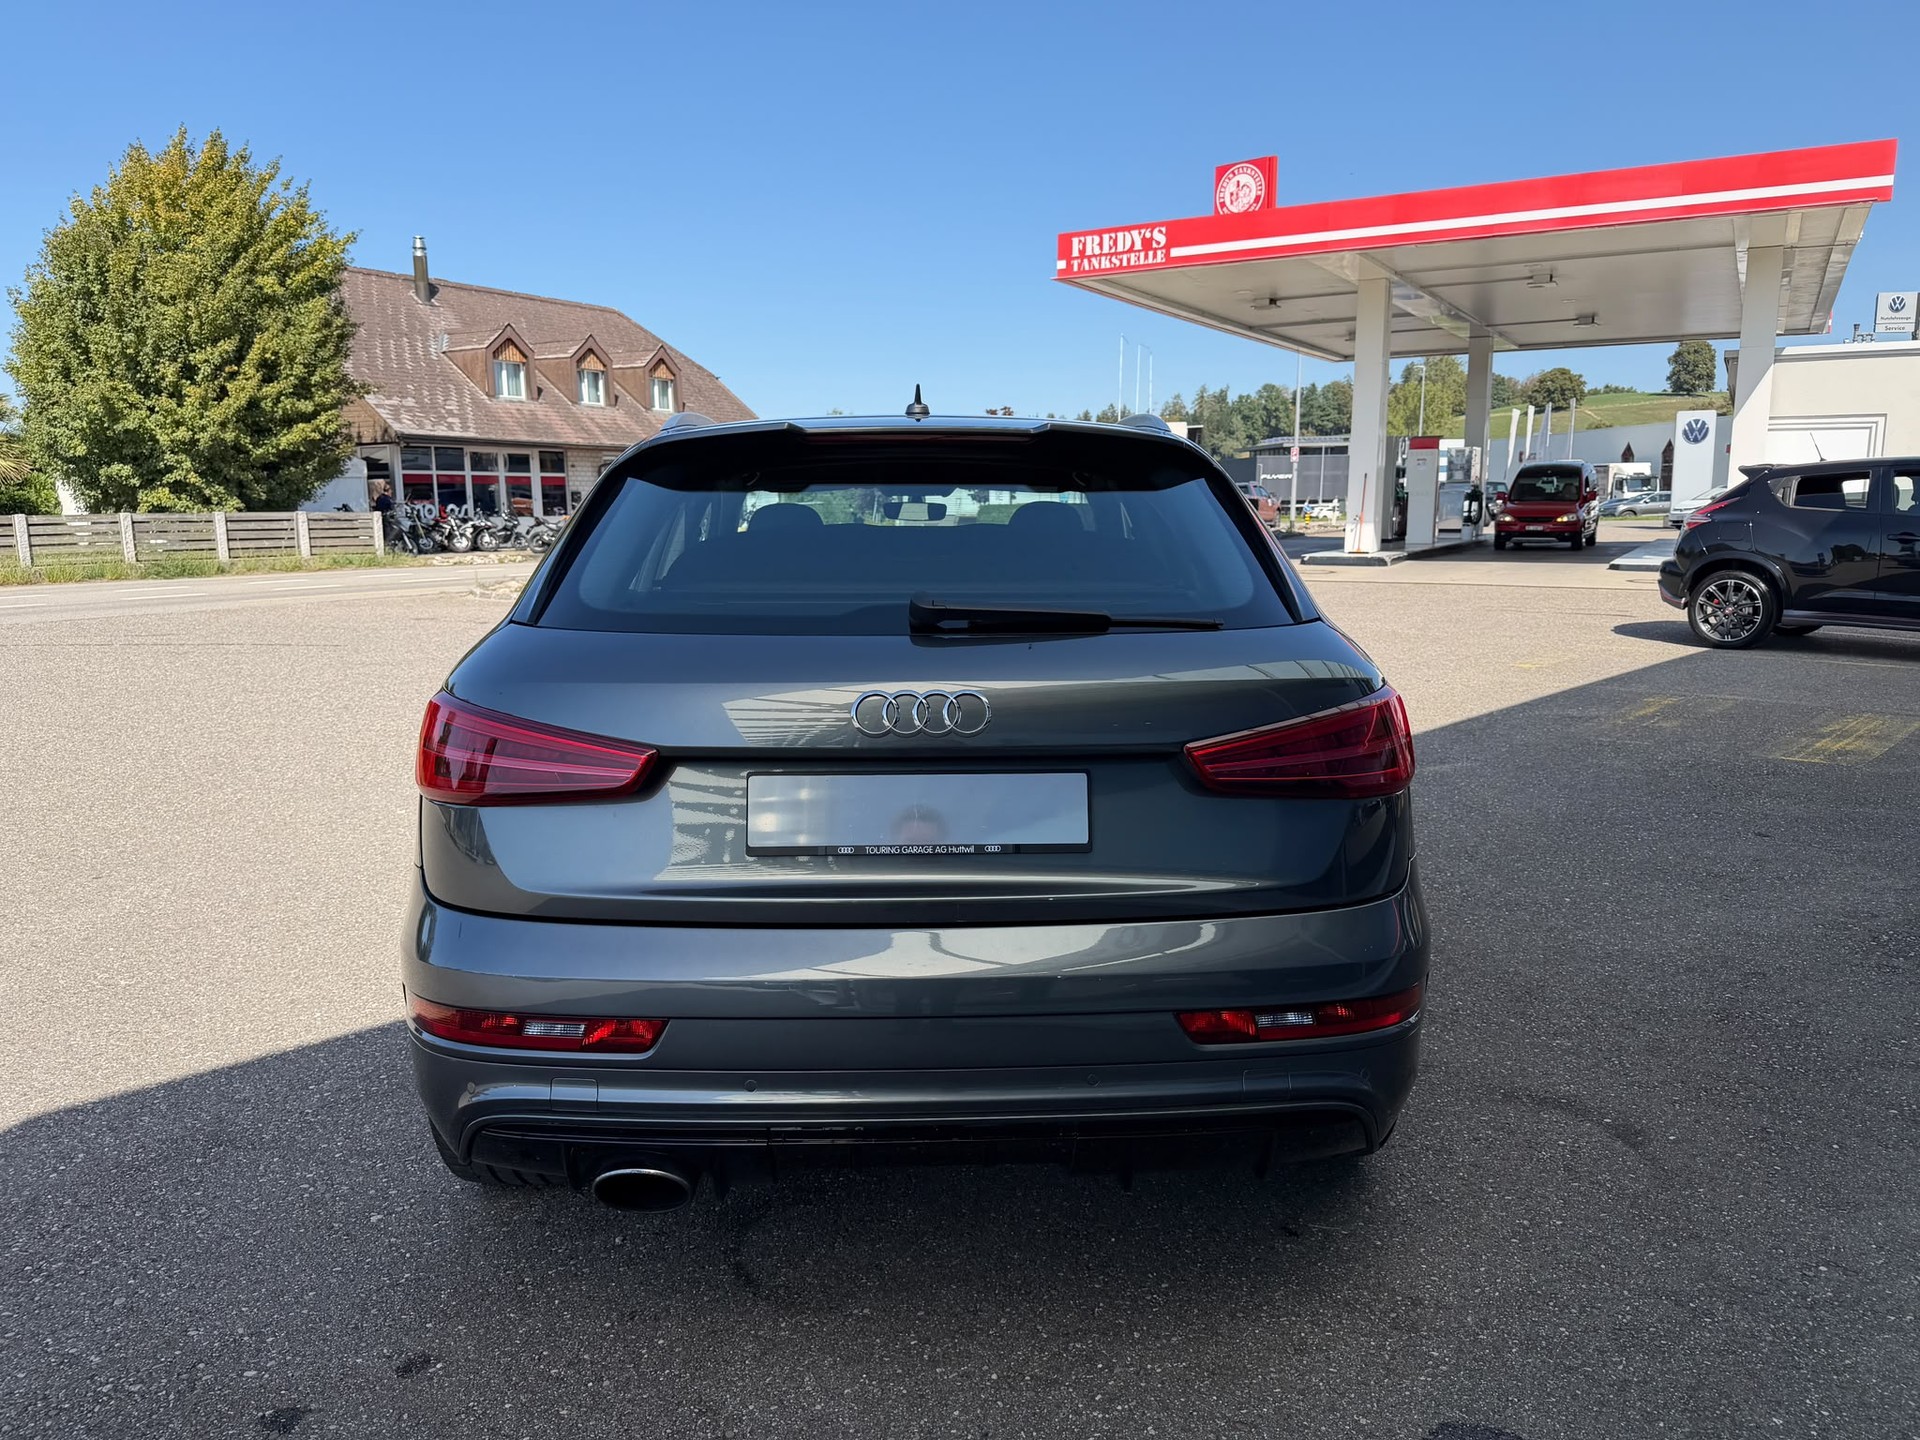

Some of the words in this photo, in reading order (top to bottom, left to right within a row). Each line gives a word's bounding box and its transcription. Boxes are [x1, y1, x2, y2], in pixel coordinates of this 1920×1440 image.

[1071, 226, 1167, 258] FREDY'S
[1071, 249, 1166, 273] TANKSTELLE
[865, 846, 900, 854] TOURING
[901, 845, 934, 854] GARAGE
[934, 845, 947, 854] AG
